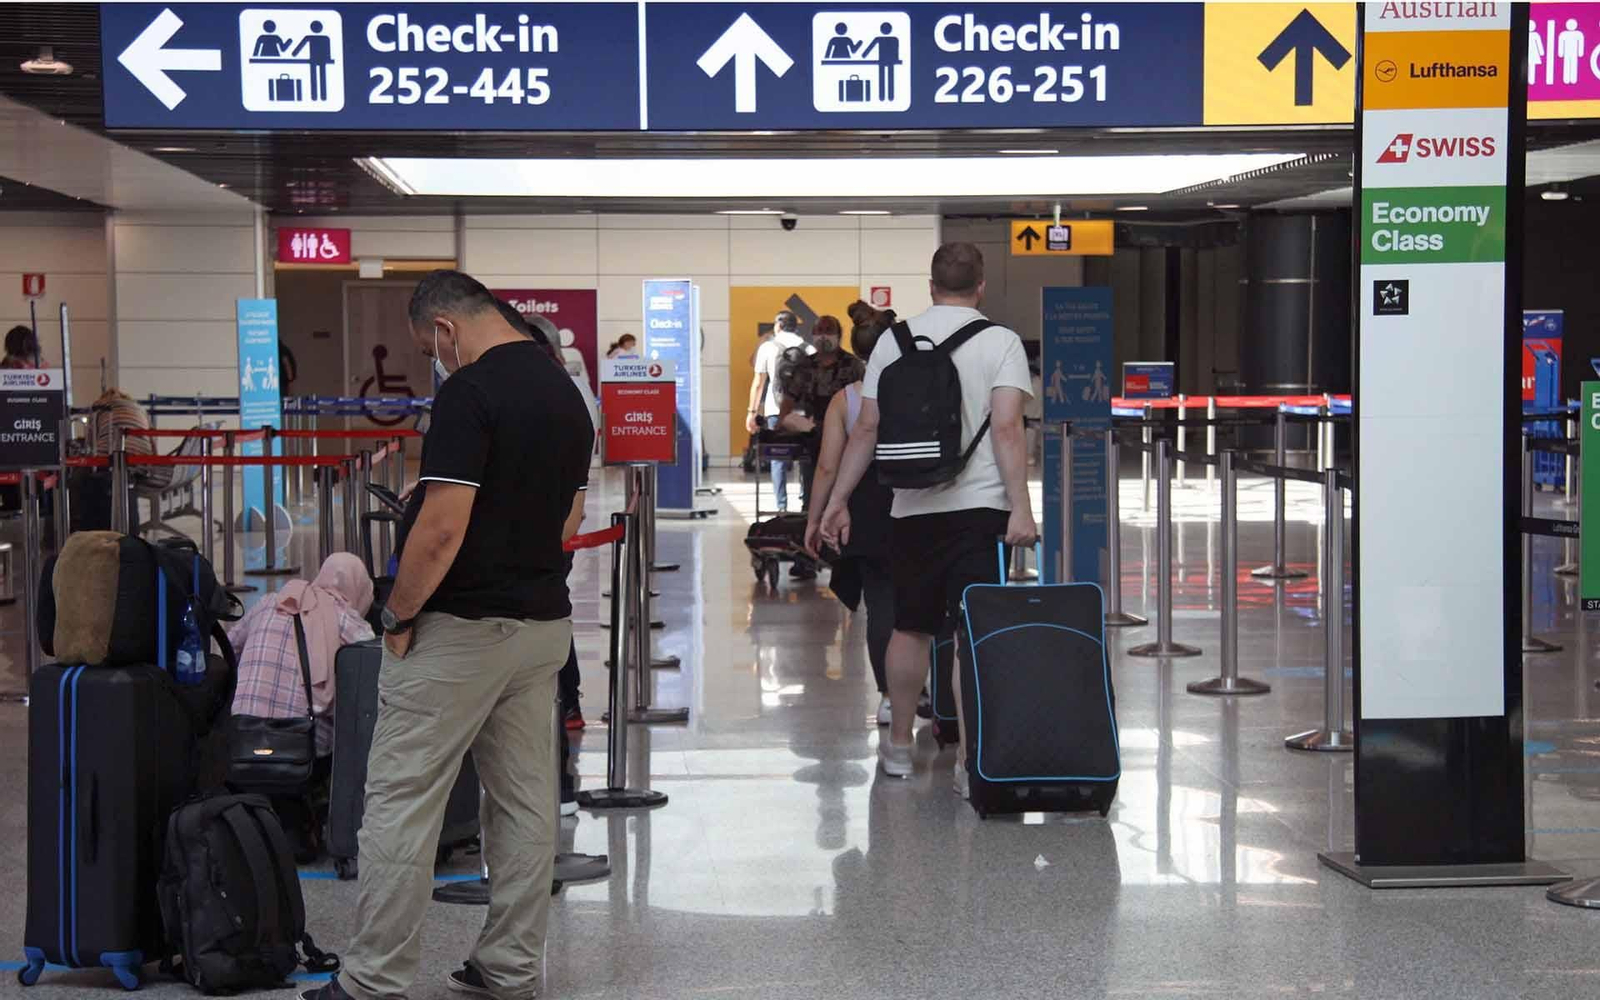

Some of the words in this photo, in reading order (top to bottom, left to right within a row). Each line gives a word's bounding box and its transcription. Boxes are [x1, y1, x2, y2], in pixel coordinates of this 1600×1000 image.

[1379, 2, 1497, 19] Austrian
[365, 12, 559, 54] Check-in
[933, 12, 1121, 53] Check-in
[1409, 62, 1498, 79] Lufthansa
[367, 65, 552, 106] 252-445
[934, 64, 1107, 104] 226-251
[1416, 136, 1496, 158] SWISS
[1372, 201, 1490, 227] Economy
[1371, 228, 1444, 252] Class
[1, 433, 55, 442] ENTRANCE
[611, 426, 667, 436] ENTRANCE
